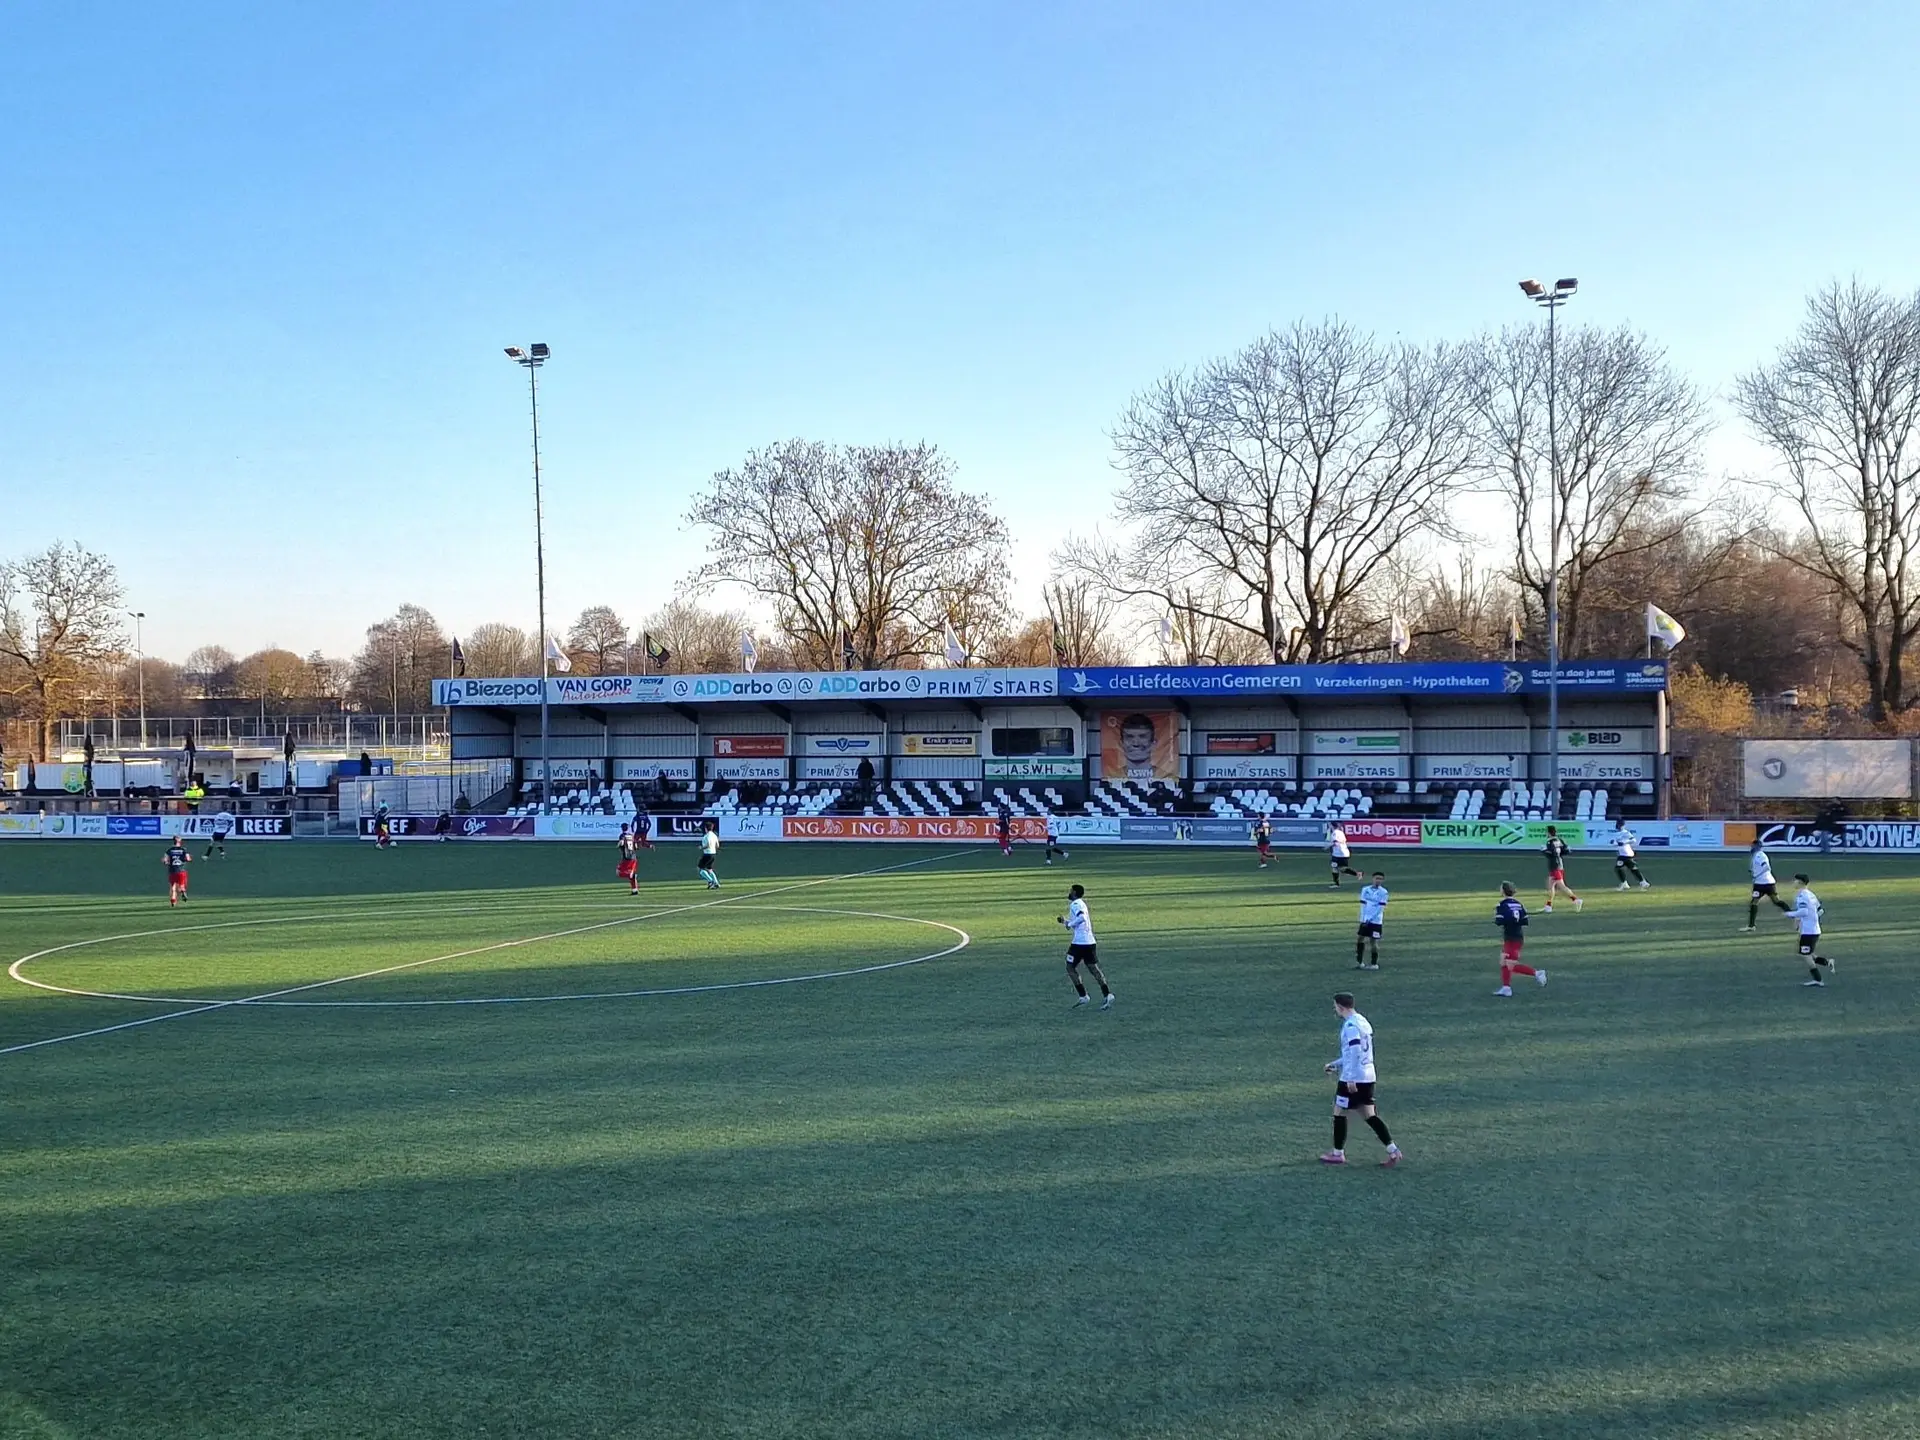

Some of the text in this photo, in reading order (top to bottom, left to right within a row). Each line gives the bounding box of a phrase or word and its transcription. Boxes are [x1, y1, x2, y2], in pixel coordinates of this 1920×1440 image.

[465, 680, 542, 699] Biezepol
[556, 679, 632, 693] VAN GORP
[694, 679, 773, 695] ADDarbo
[819, 677, 901, 693] ADDarbo
[1315, 677, 1403, 689] Verzekeringen
[1413, 676, 1489, 688] Hypotheken
[1010, 764, 1056, 775] A.S.W.H.
[243, 819, 283, 833] REEF
[367, 819, 409, 833] REF
[786, 821, 819, 834] ING
[852, 821, 884, 834] ING
[917, 822, 951, 835] ING
[1760, 825, 1842, 846] Clars
